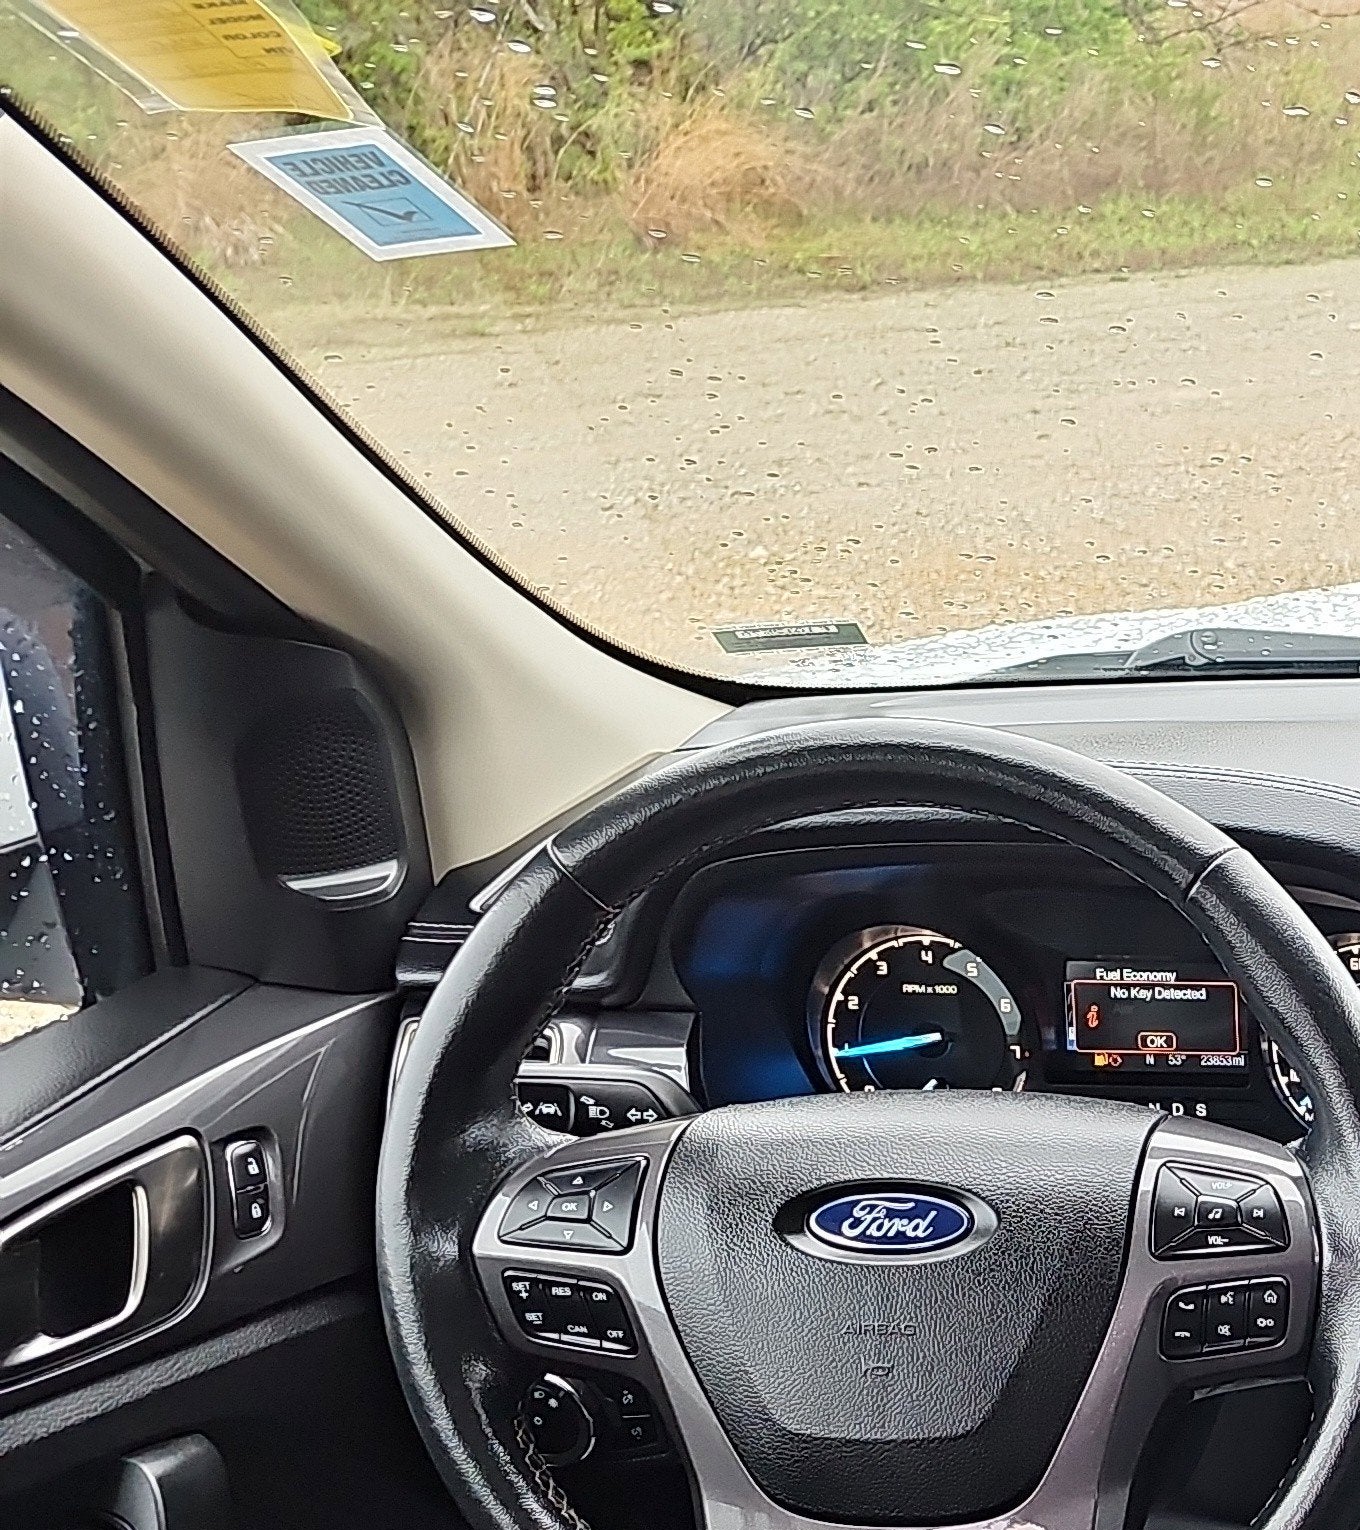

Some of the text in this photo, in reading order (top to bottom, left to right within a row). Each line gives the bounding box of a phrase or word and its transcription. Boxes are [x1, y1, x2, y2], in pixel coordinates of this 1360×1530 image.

[921, 951, 932, 963] 4
[876, 961, 888, 975] 3
[966, 962, 978, 977] 5
[1096, 969, 1176, 982] Fuel Economy
[903, 984, 926, 994] RPM
[934, 984, 957, 994] 1000
[1110, 987, 1206, 1001] No Key Detected
[848, 996, 859, 1009] 2
[1001, 999, 1011, 1012] 6
[1146, 1035, 1167, 1048] OK
[1009, 1045, 1021, 1059] 7
[1145, 1054, 1155, 1065] N
[1172, 1103, 1184, 1117] D
[1195, 1103, 1207, 1117] S
[562, 1201, 578, 1211] OK
[841, 1200, 938, 1238] Ford
[512, 1282, 531, 1291] SET
[552, 1286, 572, 1297] RES
[592, 1292, 608, 1301] ON
[525, 1312, 543, 1321] SET
[567, 1325, 588, 1334] CAN
[841, 1323, 917, 1336] AIRBAG
